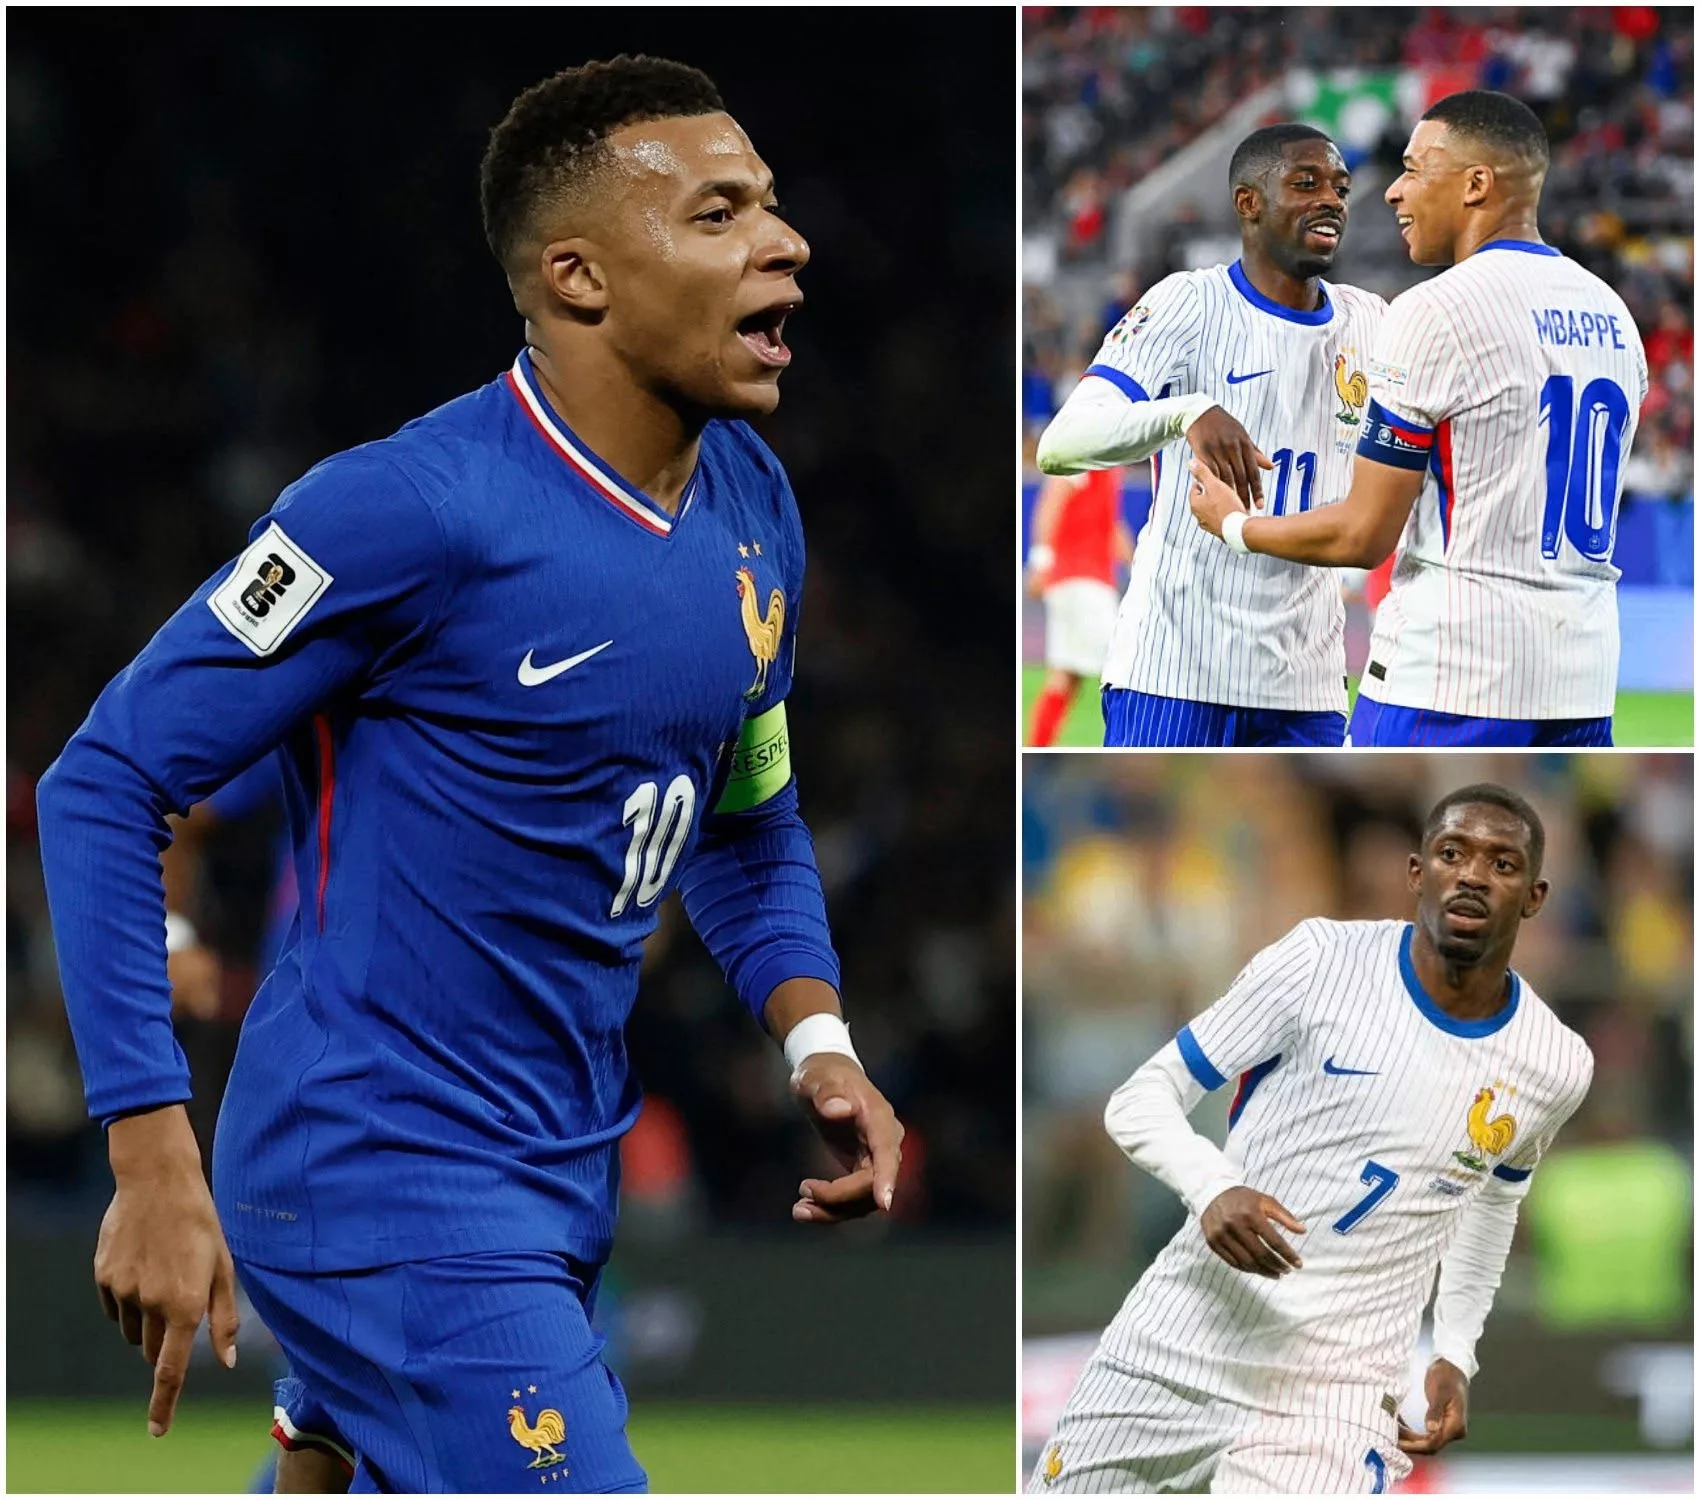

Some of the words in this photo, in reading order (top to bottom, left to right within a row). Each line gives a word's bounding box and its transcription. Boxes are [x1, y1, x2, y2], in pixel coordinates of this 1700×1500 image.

[1531, 308, 1626, 349] MBAPPE
[1272, 447, 1318, 516] 11
[1538, 375, 1630, 563] 10
[610, 774, 696, 919] 10
[1332, 1159, 1400, 1235] 7
